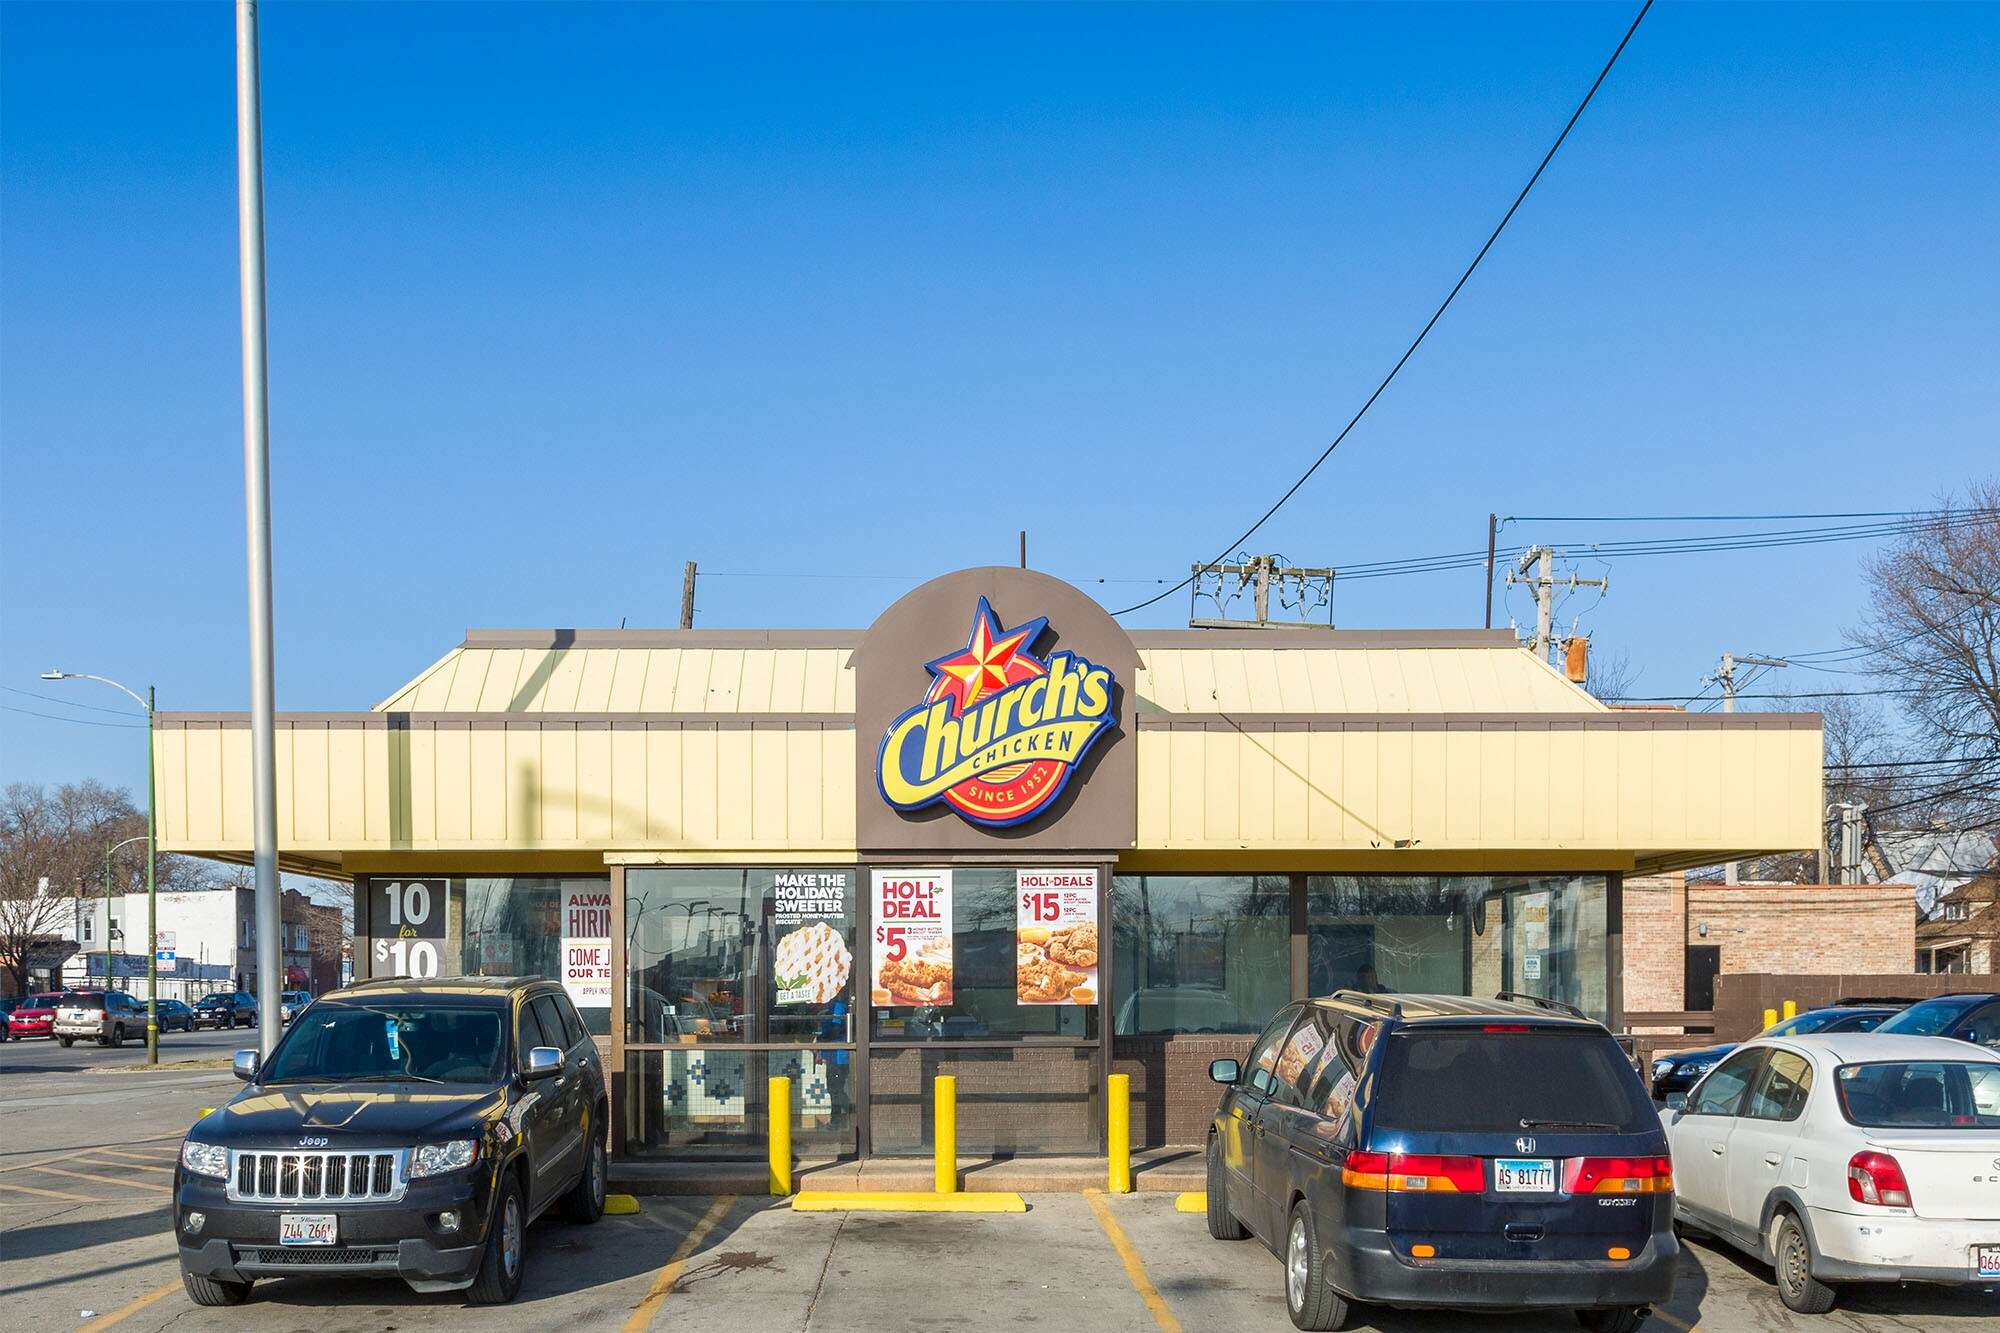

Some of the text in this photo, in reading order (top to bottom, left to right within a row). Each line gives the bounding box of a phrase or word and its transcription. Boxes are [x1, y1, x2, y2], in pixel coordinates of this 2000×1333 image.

[881, 657, 1110, 805] Church's
[973, 731, 1073, 769] CHICKEN
[969, 767, 1048, 802] SINCE 1952
[775, 874, 846, 887] MAKE THE
[568, 894, 611, 907] ALWA
[775, 886, 845, 900] HOLIDAYS
[385, 882, 431, 925] 10
[775, 899, 843, 912] SWEETER
[882, 900, 942, 918] DEAL
[1023, 892, 1061, 922] $15
[569, 909, 611, 938] HIRIN
[907, 927, 913, 935] 3
[399, 924, 418, 941] for
[876, 926, 907, 963] $5
[376, 938, 439, 979] $10
[568, 948, 601, 966] COME
[568, 968, 593, 978] OUR
[598, 986, 612, 995] INSI
[779, 989, 811, 1001] GET A TASTE
[299, 1135, 329, 1147] Jeep
[1499, 1169, 1552, 1185] AS 81777
[1598, 1198, 1637, 1206] ODYSSEY
[283, 1223, 303, 1239] Z44
[1980, 1255, 2000, 1270] Q66
